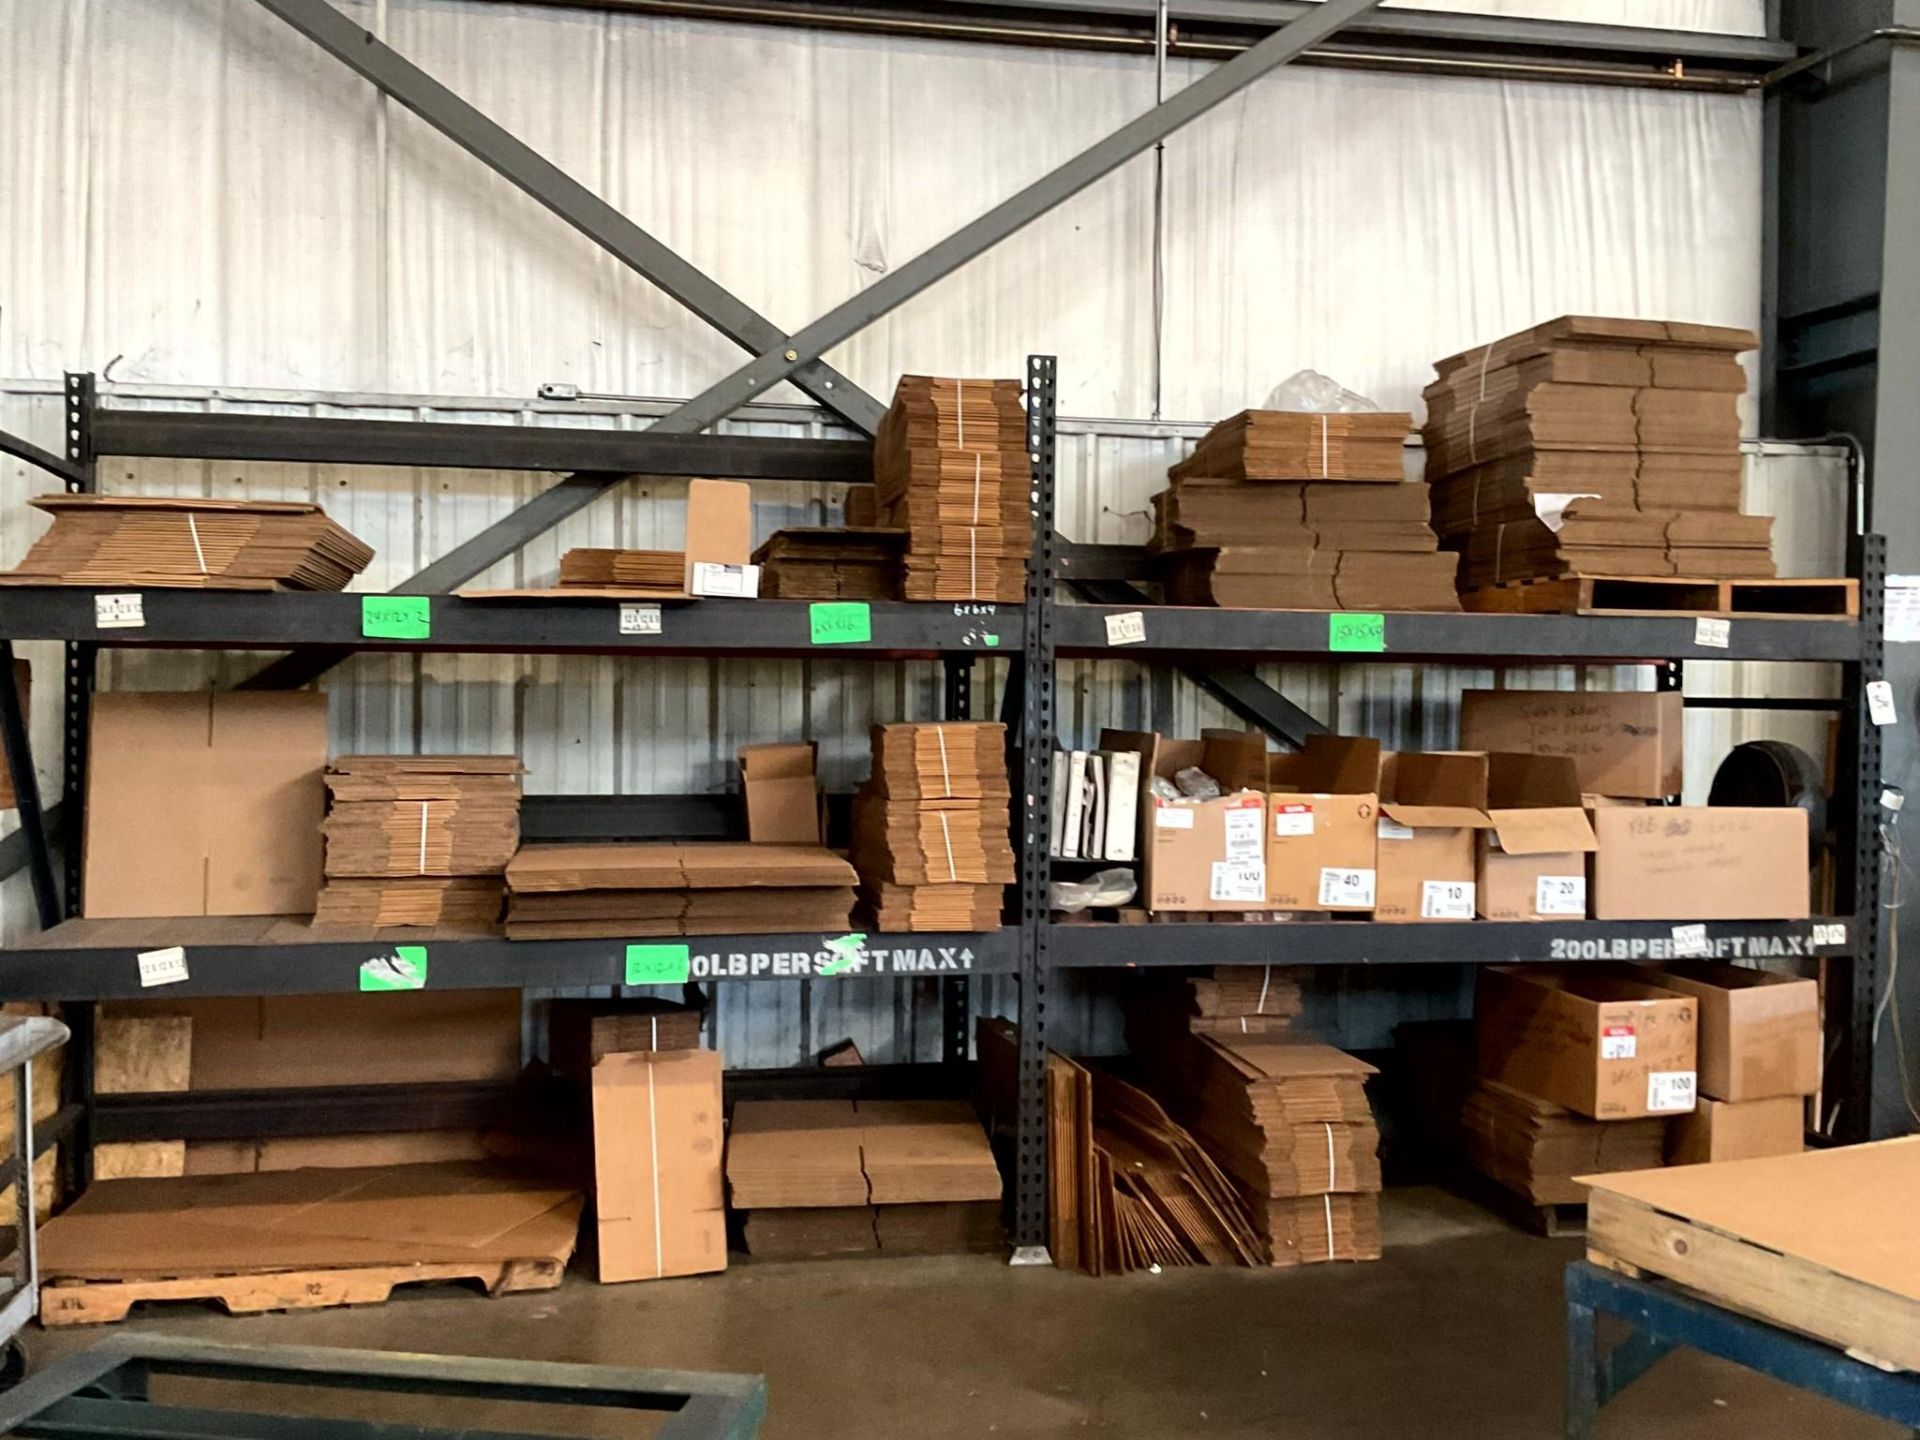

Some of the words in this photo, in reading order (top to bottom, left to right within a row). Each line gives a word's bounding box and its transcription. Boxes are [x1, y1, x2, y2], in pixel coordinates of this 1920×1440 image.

[1342, 873, 1360, 888] 40
[1447, 886, 1463, 900] 10
[1558, 881, 1575, 895] 20
[1671, 1076, 1692, 1091] 100
